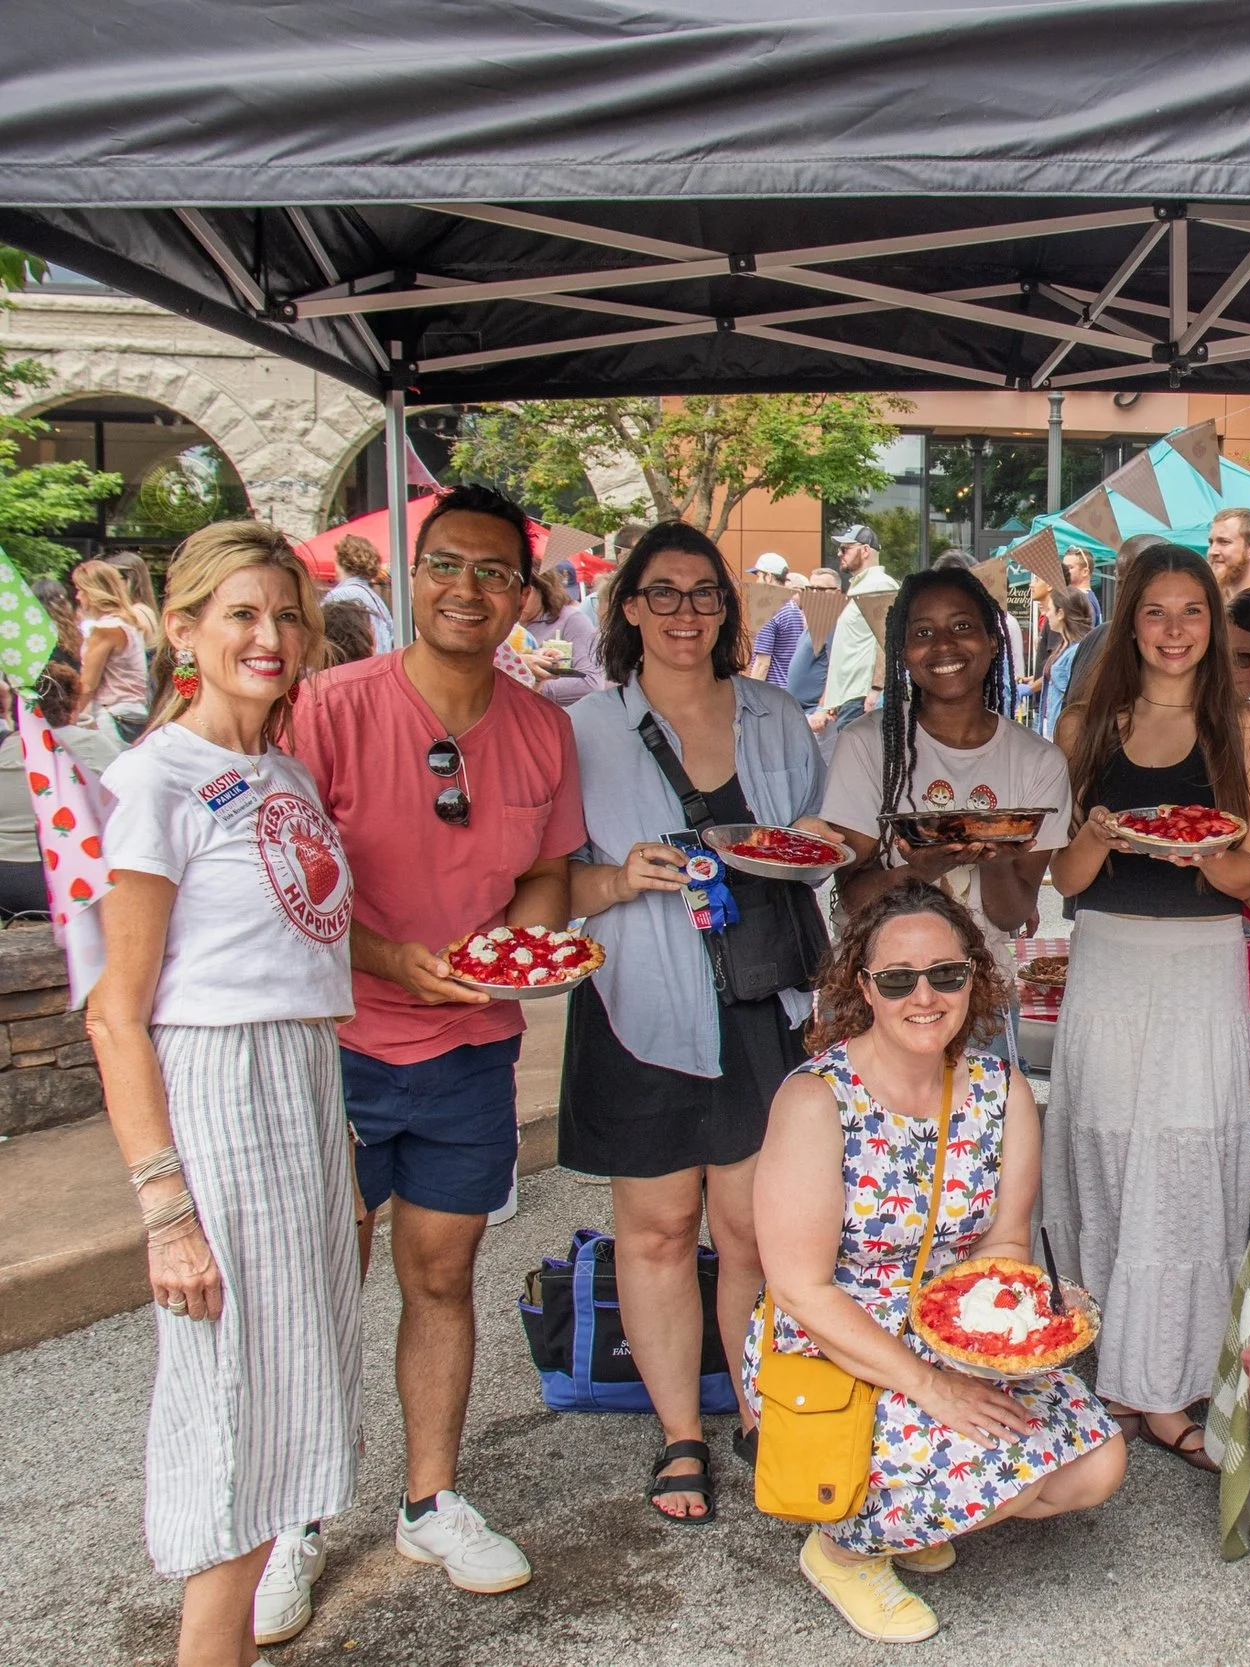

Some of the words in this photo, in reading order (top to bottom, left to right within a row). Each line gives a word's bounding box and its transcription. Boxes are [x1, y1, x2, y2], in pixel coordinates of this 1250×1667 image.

[198, 768, 242, 802] KRISTIN
[215, 785, 243, 806] PAWLIK
[222, 812, 234, 822] Vote
